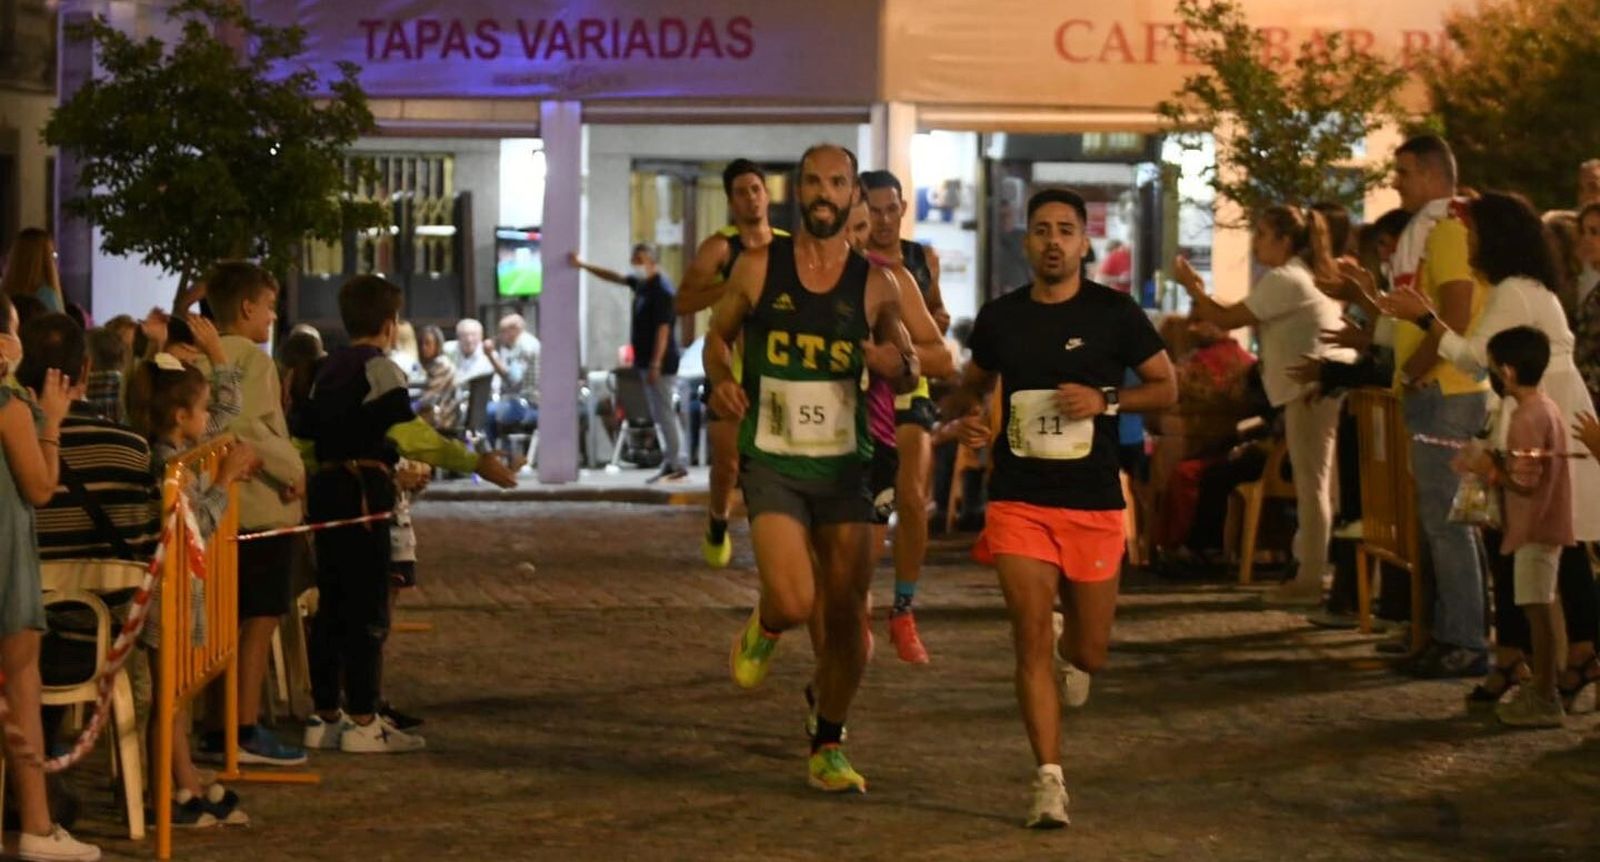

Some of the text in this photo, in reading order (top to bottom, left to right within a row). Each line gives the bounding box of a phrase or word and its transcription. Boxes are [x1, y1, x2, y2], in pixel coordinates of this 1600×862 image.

[359, 16, 754, 60] TAPAS VARIADAS
[767, 331, 853, 371] CTS
[799, 405, 825, 424] 55
[1037, 416, 1063, 435] 11
